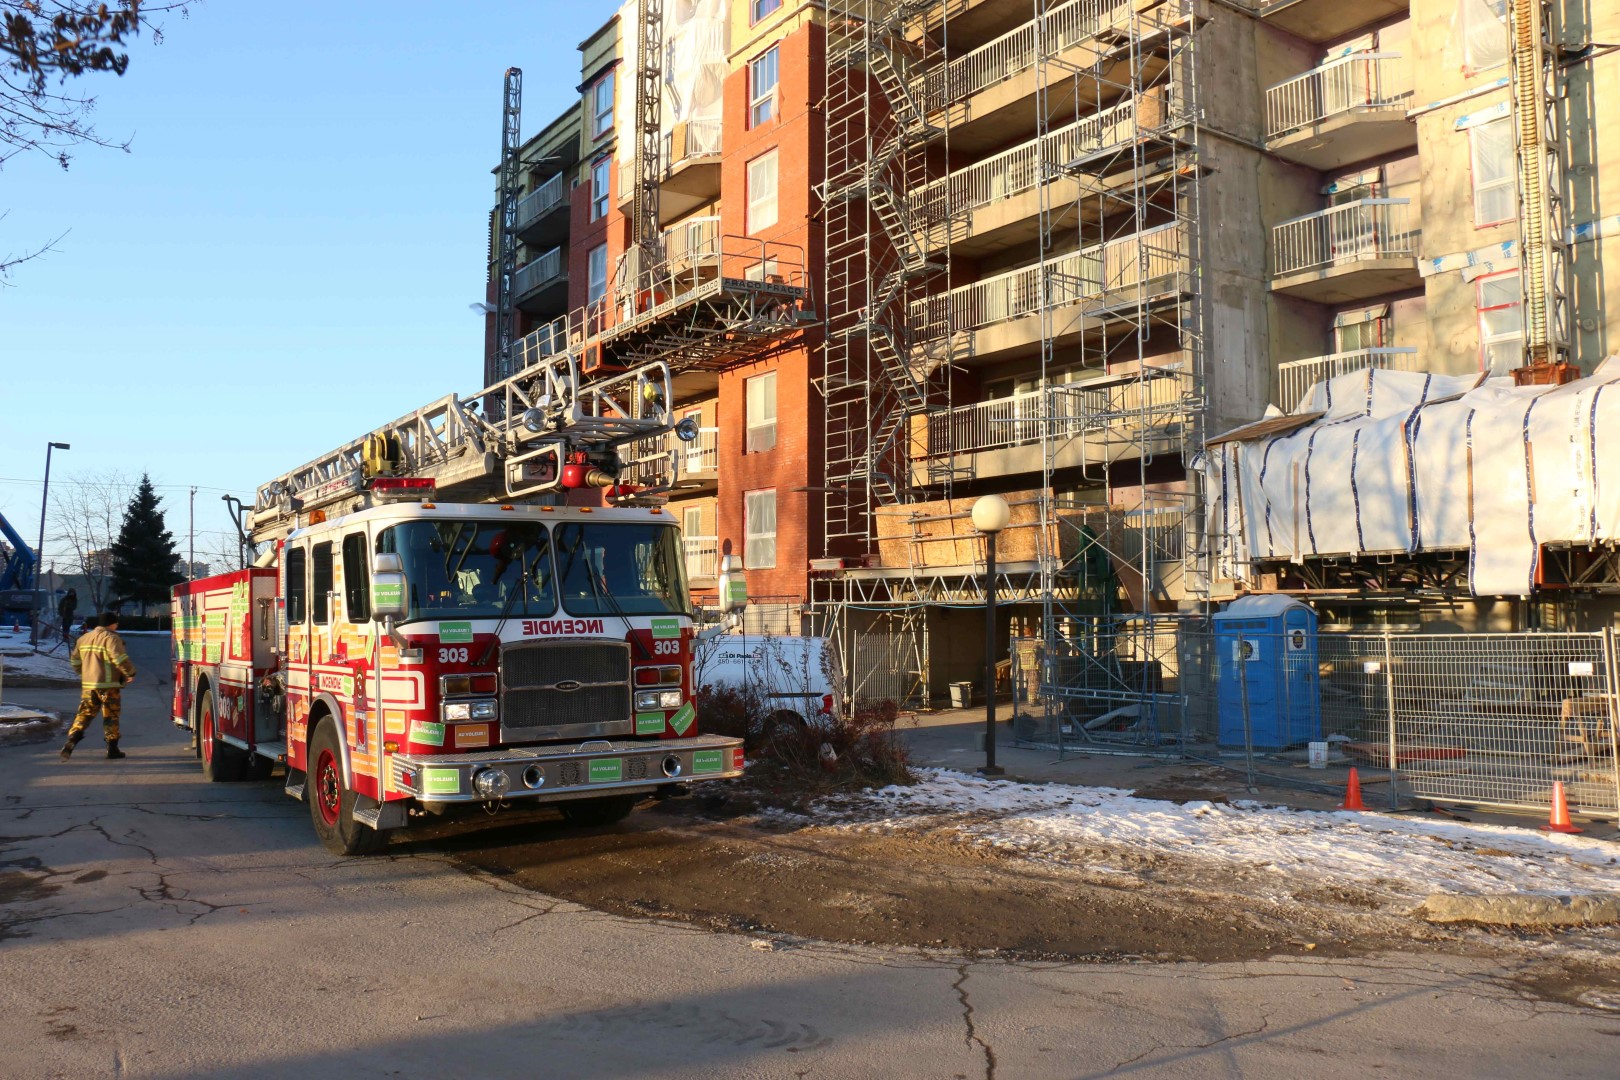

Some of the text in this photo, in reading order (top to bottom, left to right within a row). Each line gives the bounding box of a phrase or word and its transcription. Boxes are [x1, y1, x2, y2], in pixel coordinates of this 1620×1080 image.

[699, 281, 718, 294] FRACO
[725, 280, 802, 294] FRACO FRACO
[655, 301, 672, 312] FRACO
[636, 310, 653, 322] FRACO
[617, 319, 634, 332] FRACO
[600, 328, 616, 339] FRACO
[655, 640, 679, 655] 303
[438, 648, 468, 663] 303
